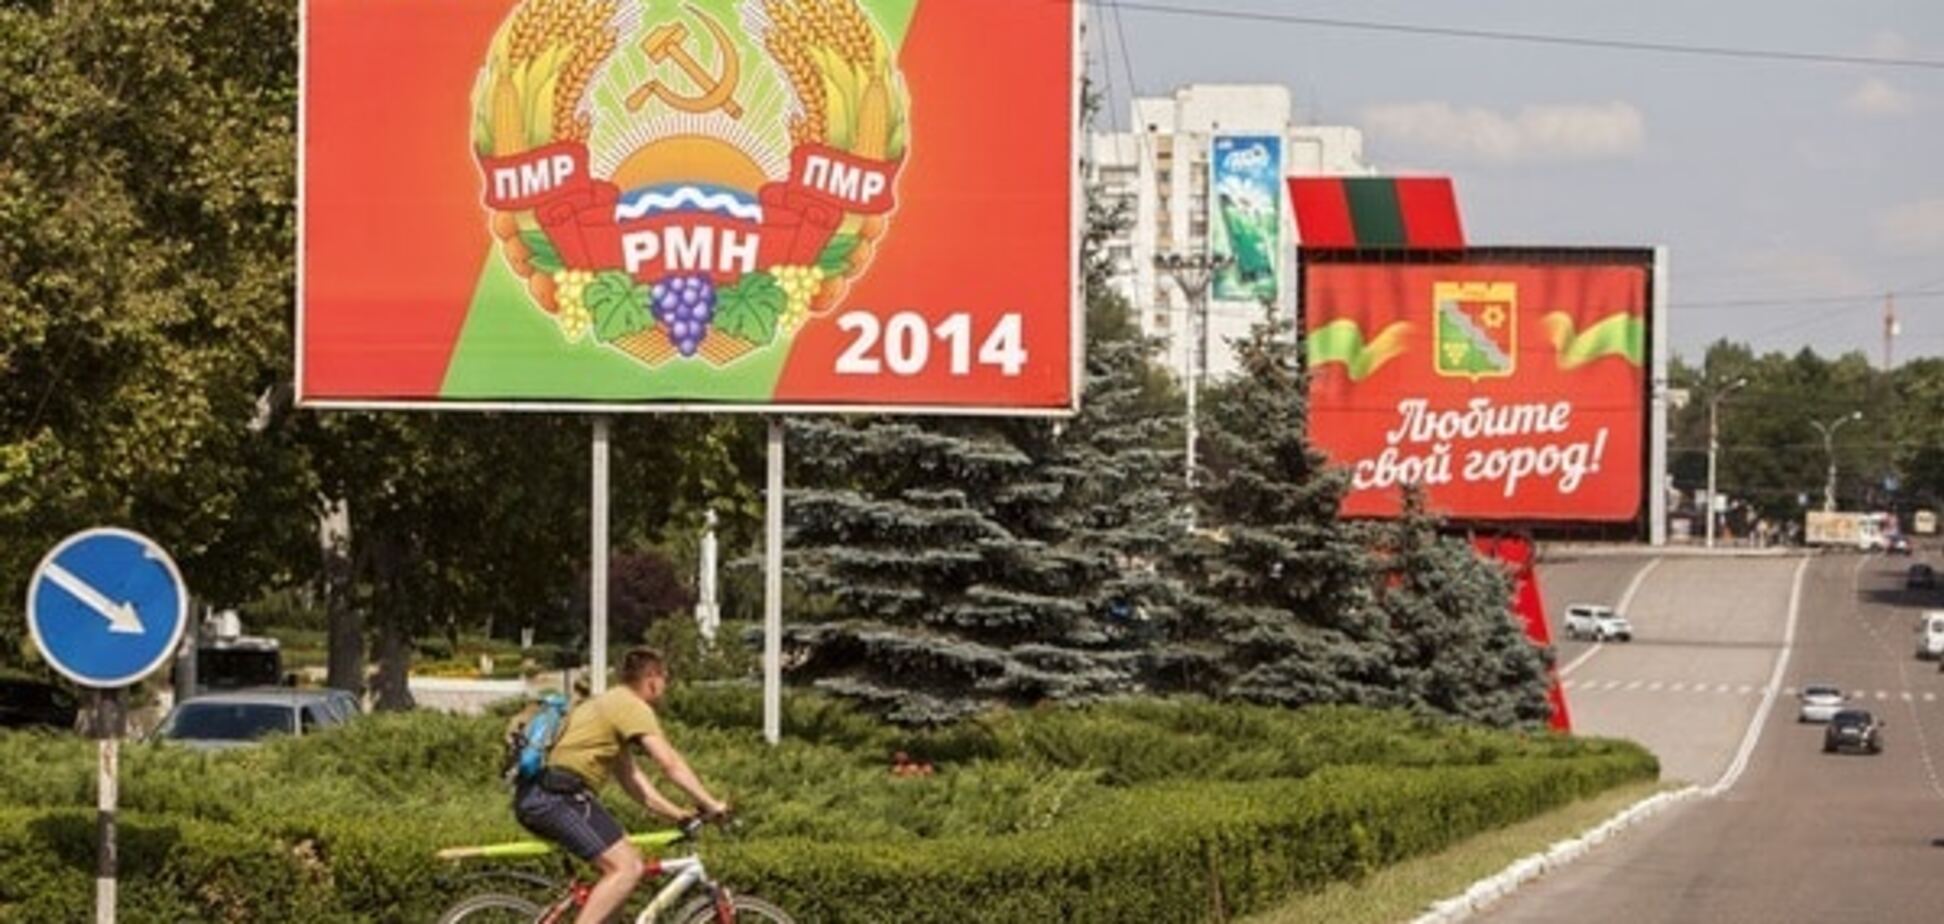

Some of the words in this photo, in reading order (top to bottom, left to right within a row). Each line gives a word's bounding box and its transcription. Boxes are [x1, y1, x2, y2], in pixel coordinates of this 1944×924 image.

[493, 153, 576, 200] ПМР
[802, 154, 886, 204] ПМР
[621, 225, 760, 275] РМН
[834, 311, 1029, 377] 2014
[1387, 397, 1571, 445] Любите
[1352, 442, 1453, 490] свой
[1462, 428, 1609, 498] город!
